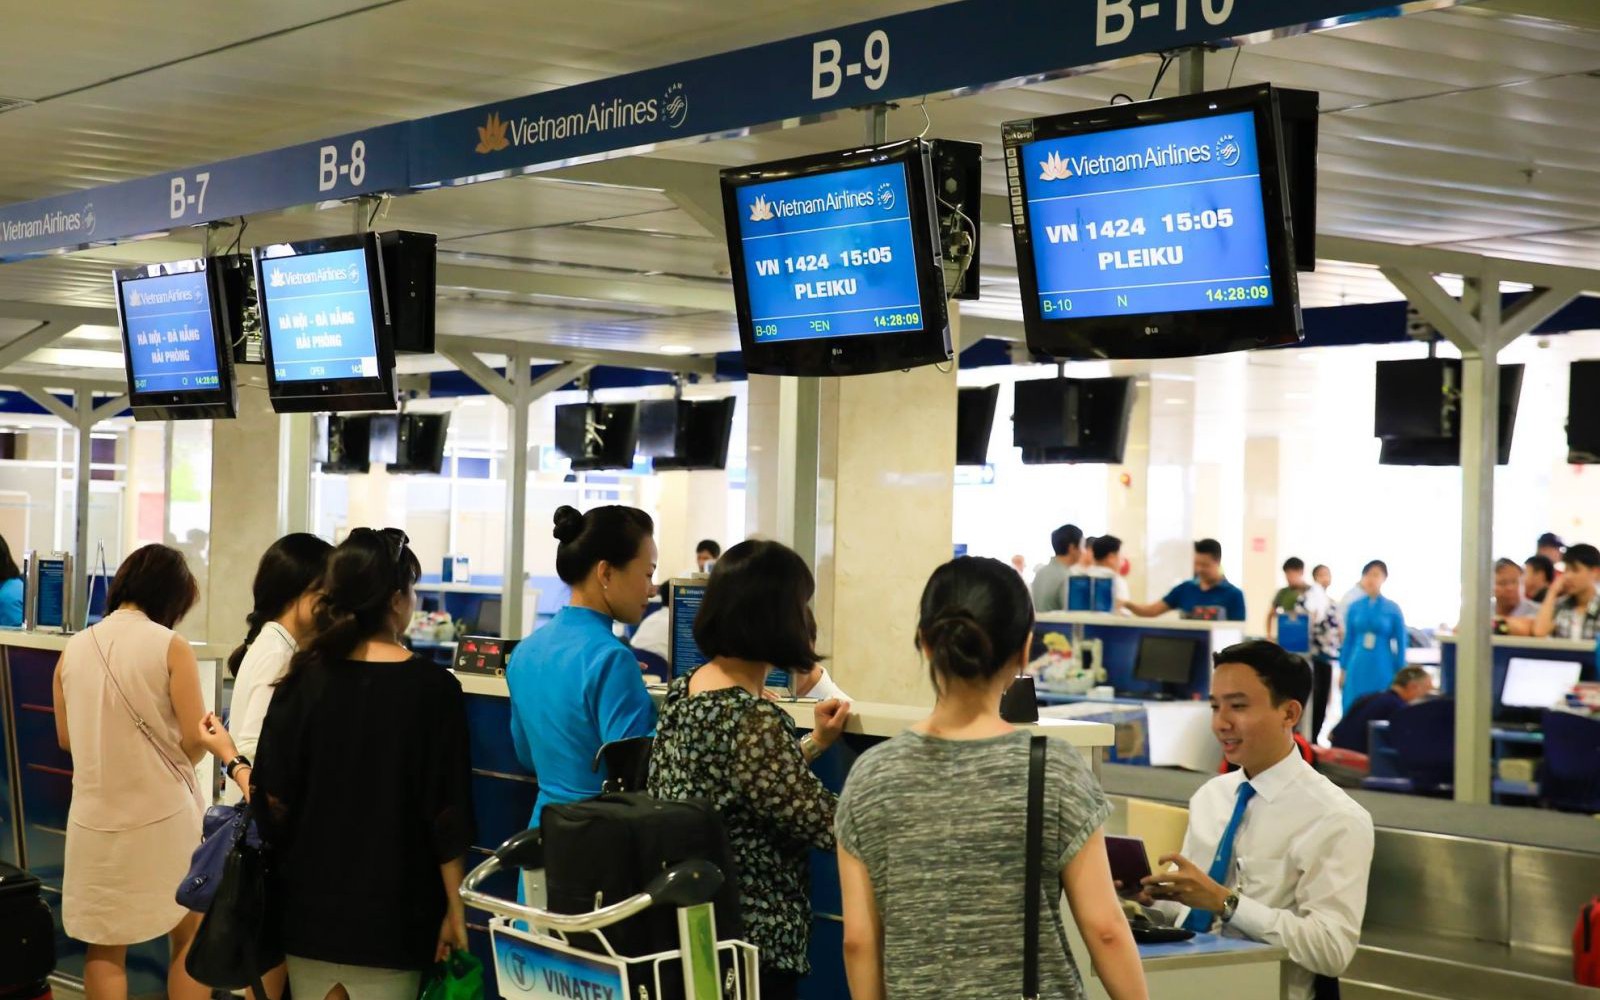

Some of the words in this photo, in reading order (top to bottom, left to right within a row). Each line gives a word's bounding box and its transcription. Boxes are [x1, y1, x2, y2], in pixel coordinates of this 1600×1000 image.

[812, 30, 890, 99] B-9
[511, 113, 584, 146] Vietnam
[585, 98, 658, 135] Airlines
[319, 140, 366, 192] B-8
[1071, 151, 1142, 176] Vietnam
[1144, 143, 1211, 168] Airlines
[170, 172, 210, 220] B-7
[772, 198, 825, 217] Vietnam
[826, 190, 874, 212] Airlines
[2, 219, 42, 241] Vietnam
[43, 211, 81, 235] Airlines
[1046, 224, 1078, 244] VN
[1086, 217, 1146, 240] 1424
[1161, 208, 1234, 233] 15:05
[755, 259, 779, 276] VN
[785, 254, 829, 273] 1424
[840, 246, 892, 267] 15:05
[1098, 246, 1184, 270] PLEIKU
[794, 278, 857, 300] PLEIKU
[1206, 285, 1269, 302] 14:28:09
[874, 312, 919, 328] 14:28:09
[1043, 299, 1072, 312] B-10
[756, 324, 777, 336] B-09
[542, 967, 614, 1000] VINATEX
